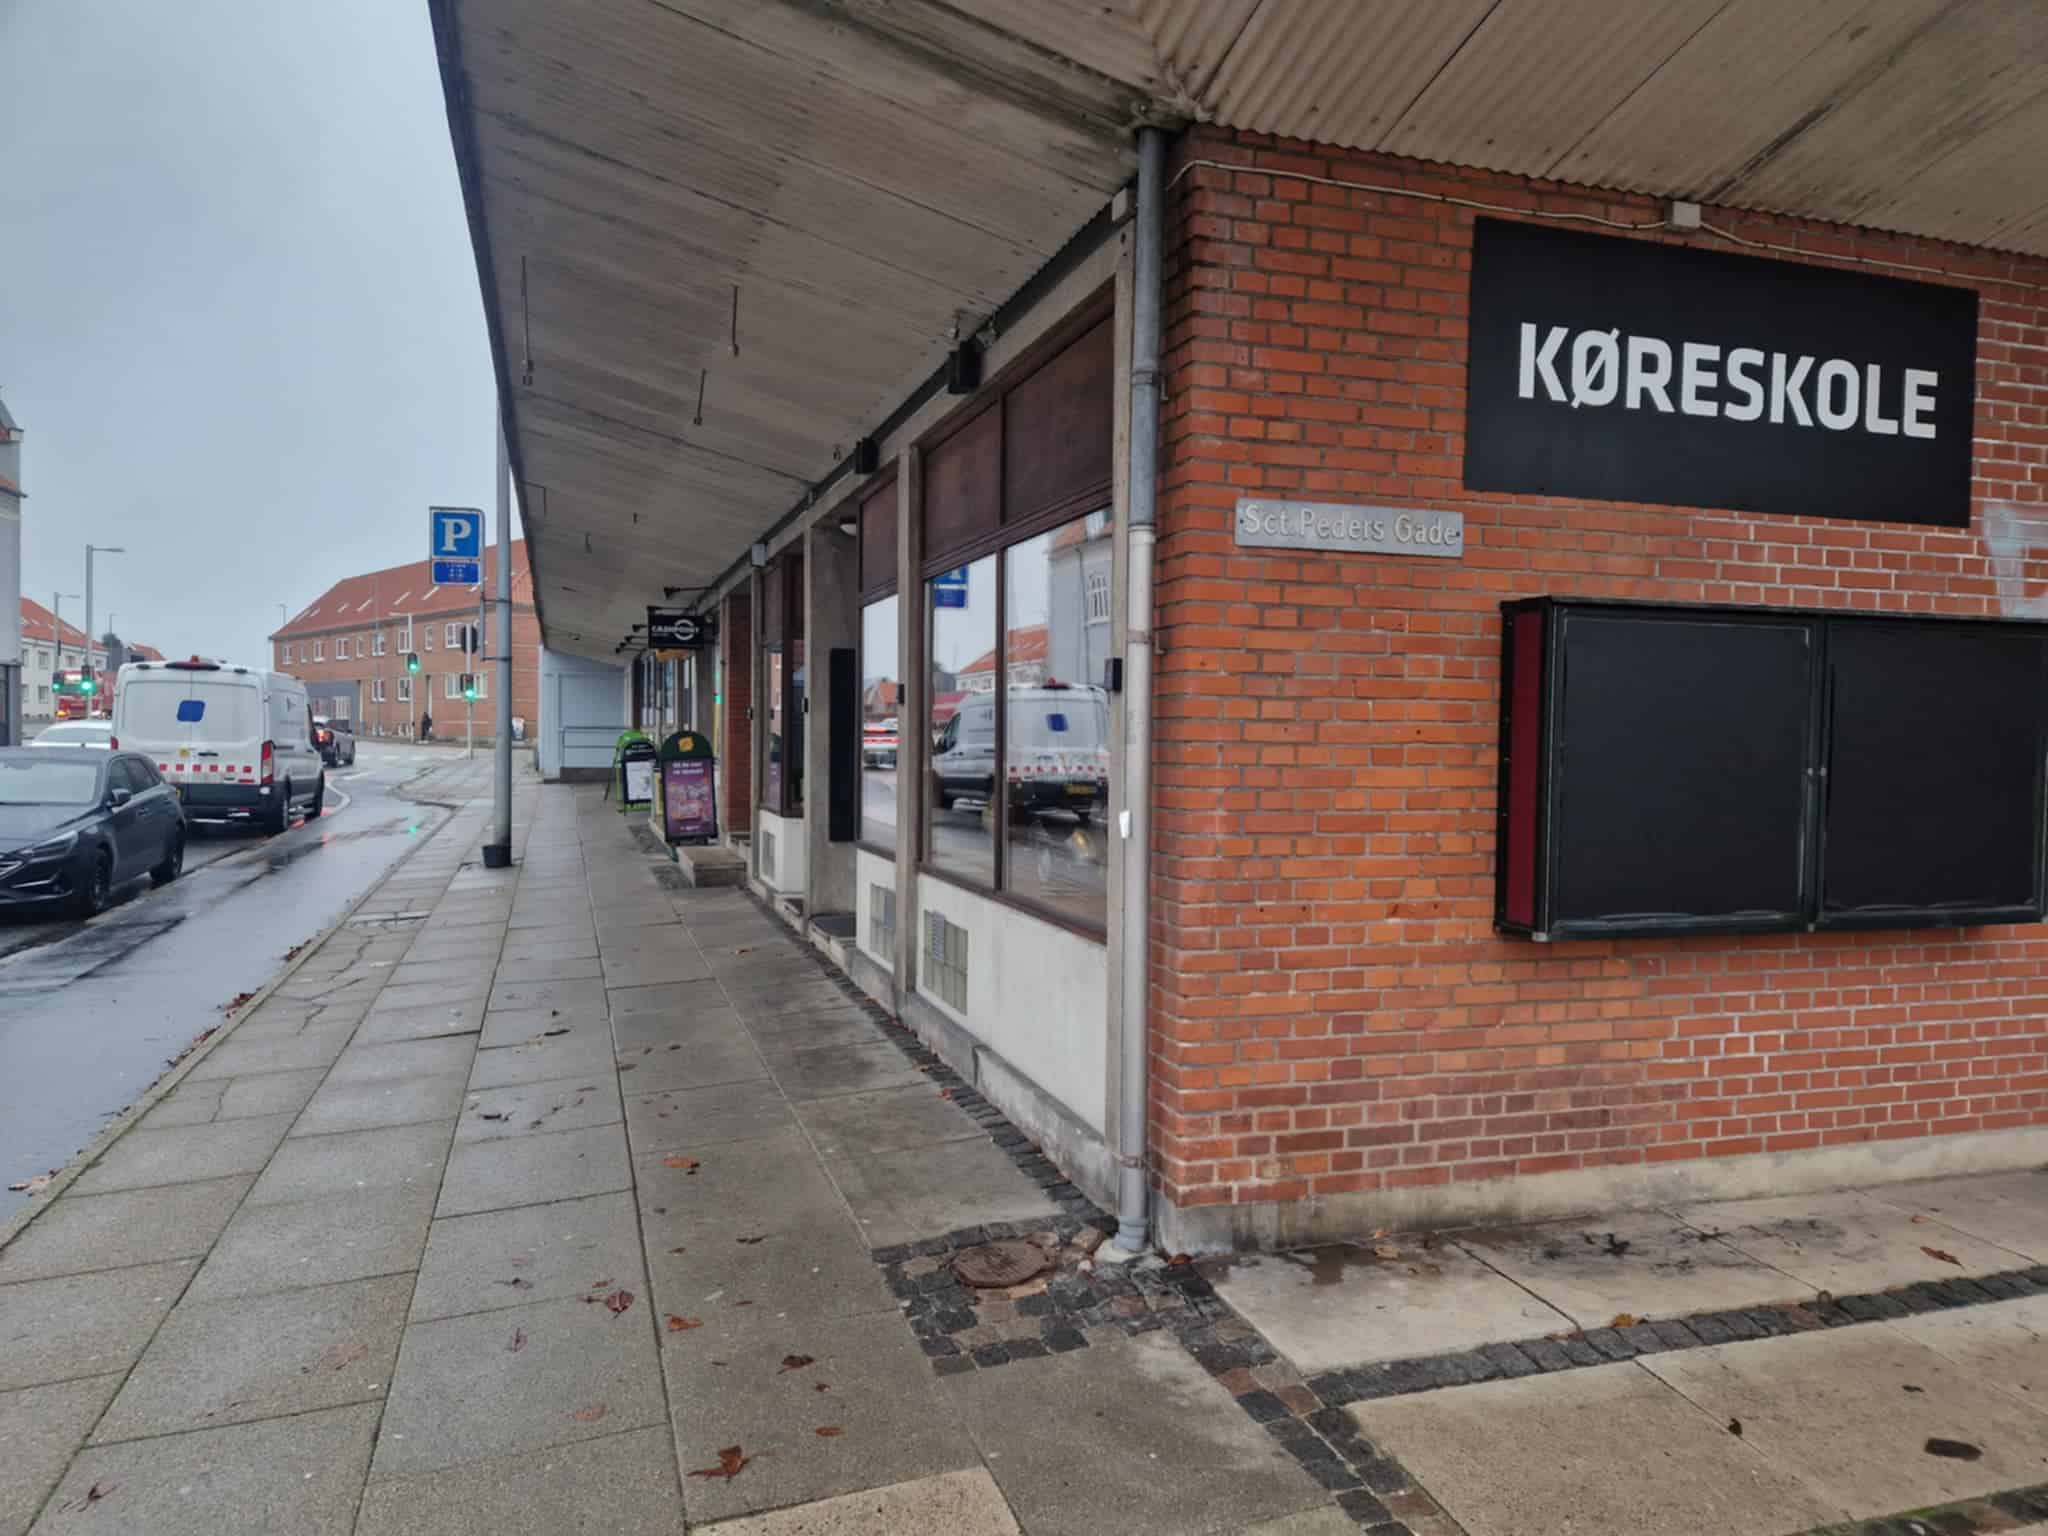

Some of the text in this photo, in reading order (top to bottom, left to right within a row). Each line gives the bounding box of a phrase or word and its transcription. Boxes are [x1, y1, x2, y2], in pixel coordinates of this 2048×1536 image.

[1518, 321, 1939, 439] KØRESKOLE
[440, 518, 472, 553] P
[1300, 508, 1386, 542] Peders
[1395, 513, 1459, 546] Gade
